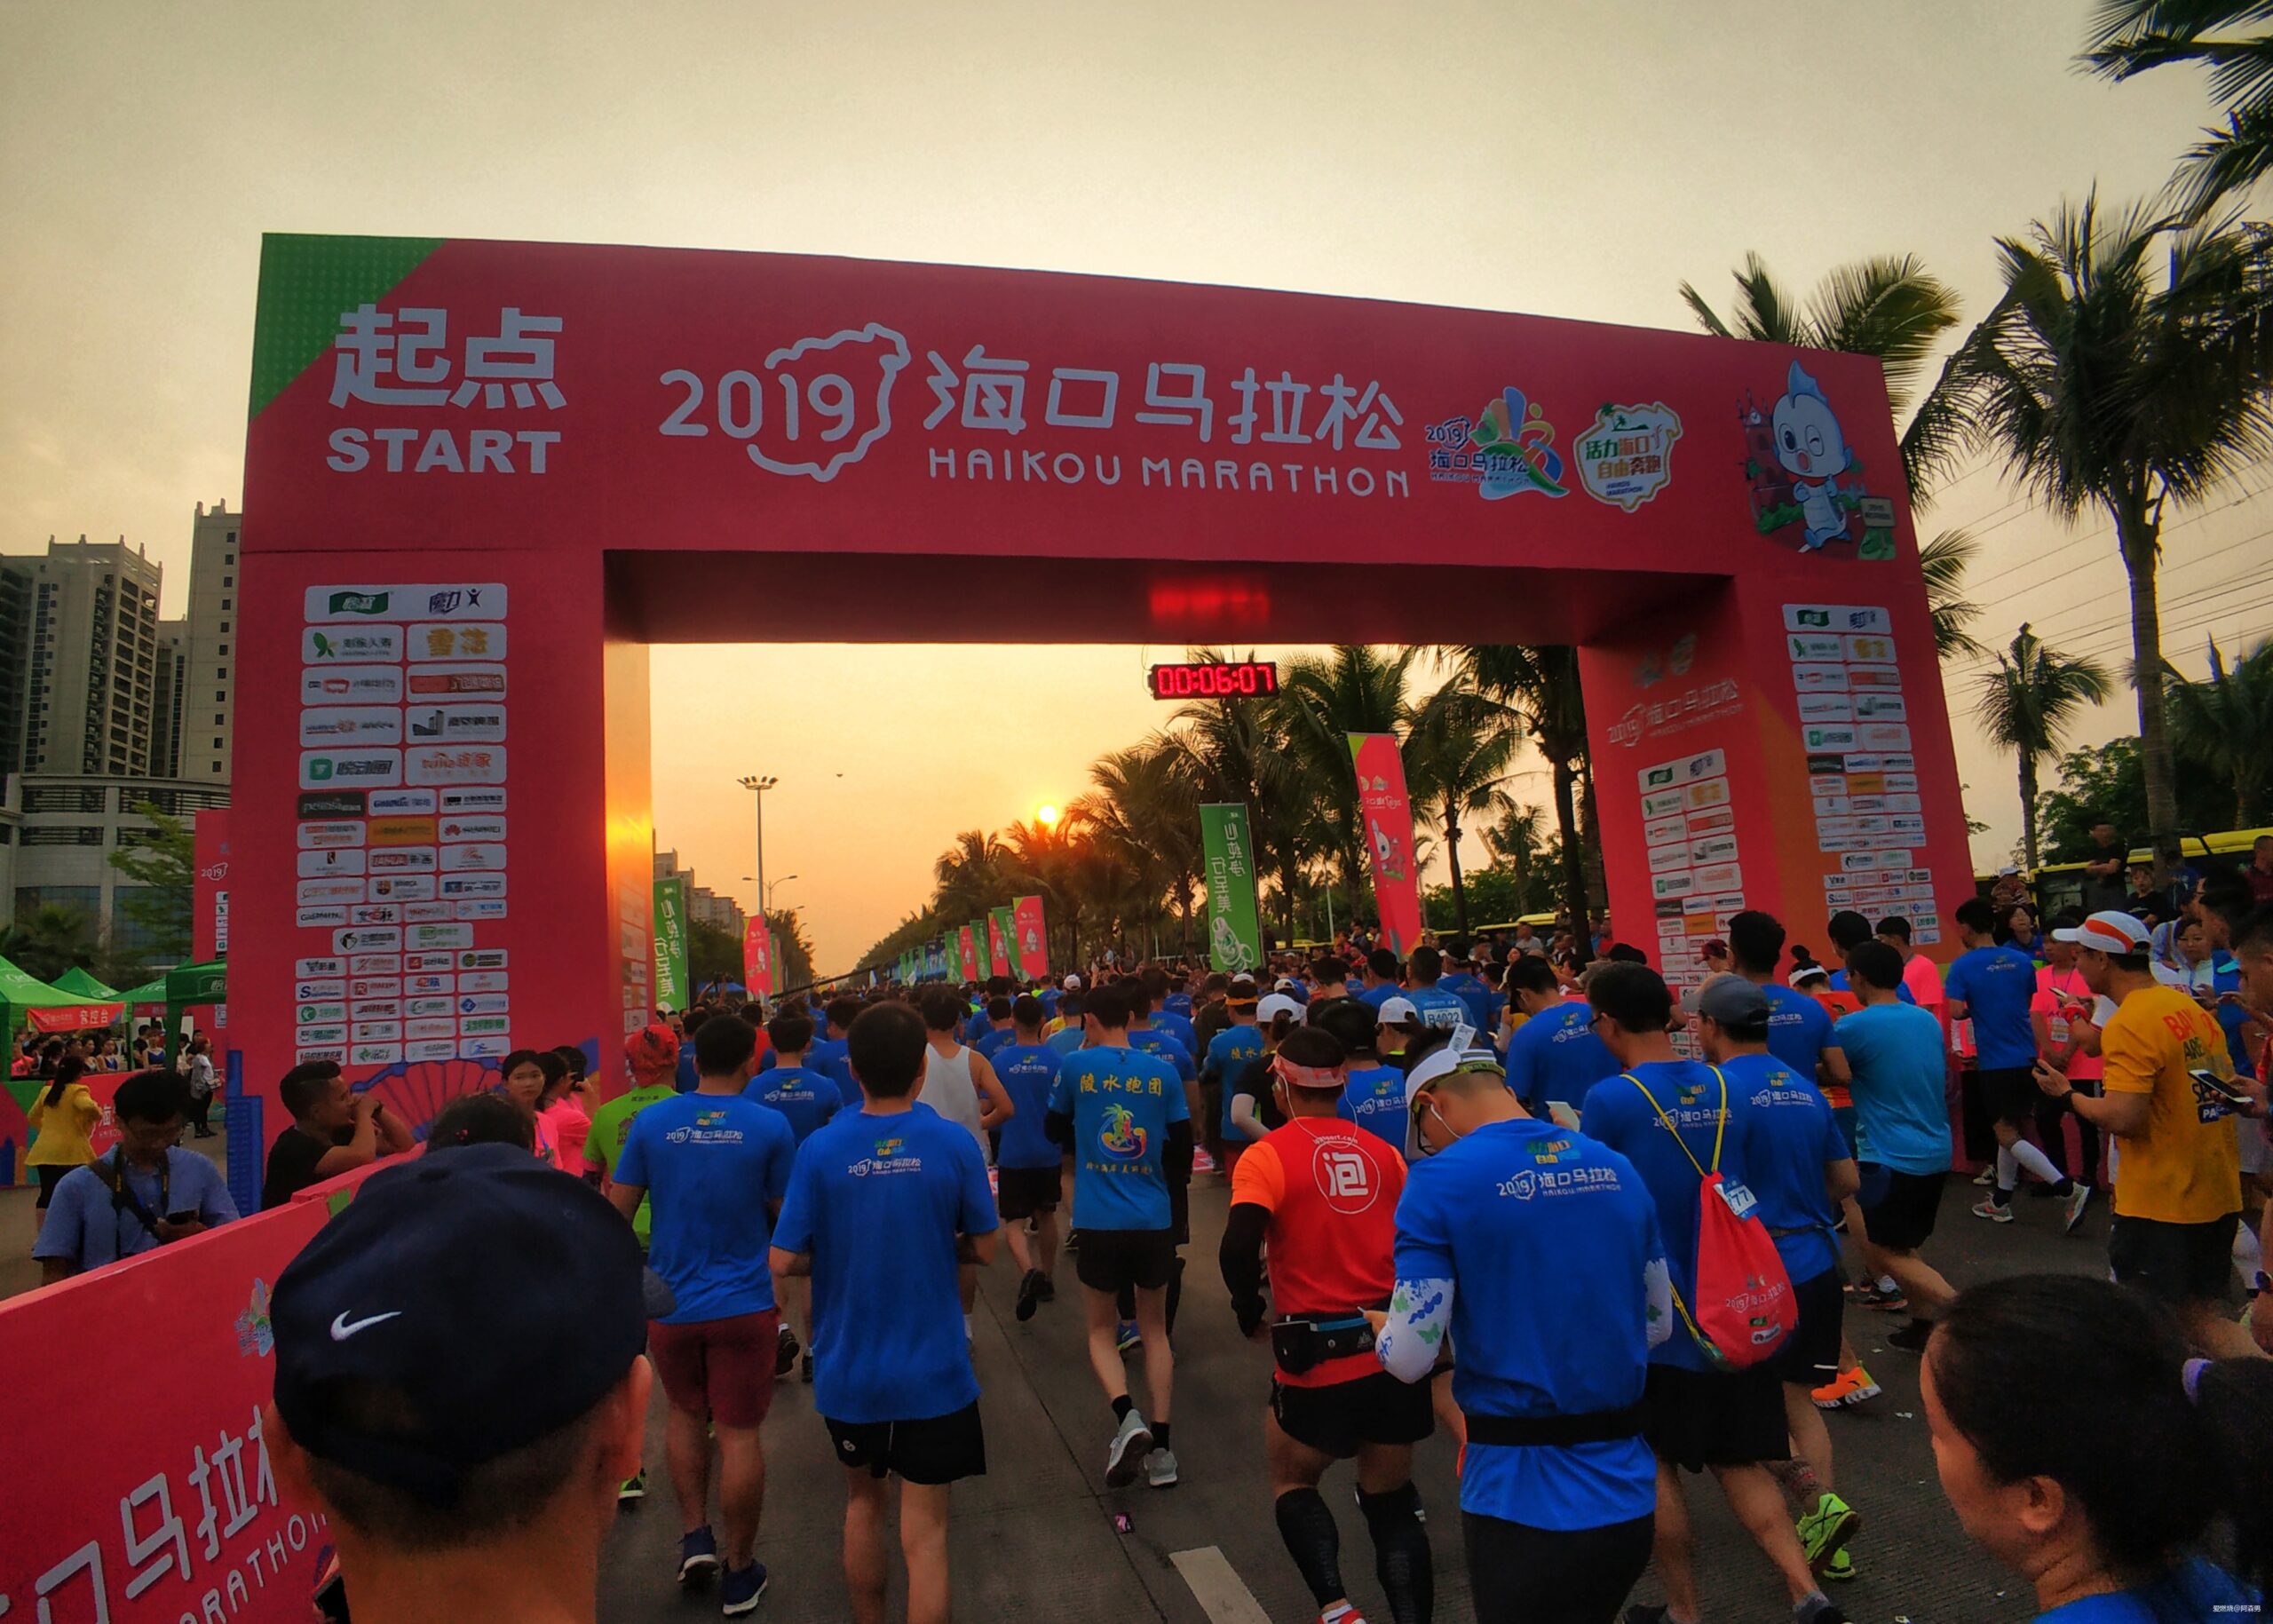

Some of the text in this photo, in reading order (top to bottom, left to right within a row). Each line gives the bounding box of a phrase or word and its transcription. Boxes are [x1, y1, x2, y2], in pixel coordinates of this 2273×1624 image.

[328, 303, 568, 410] 起点
[659, 344, 1405, 451] 2019 海口马拉松
[1426, 426, 1462, 443] 2019
[326, 427, 562, 475] START
[1430, 449, 1529, 472] 海口马拉松
[1585, 436, 1650, 460] 活力海口
[928, 447, 1410, 498] HAIKOU MARATHON
[1157, 666, 1273, 695] 00:06:07
[201, 867, 223, 878] 2019
[1080, 1073, 1162, 1097] 陵水跑团
[847, 1163, 867, 1174] 2019
[1496, 1167, 1618, 1197] 2019 海口马拉松
